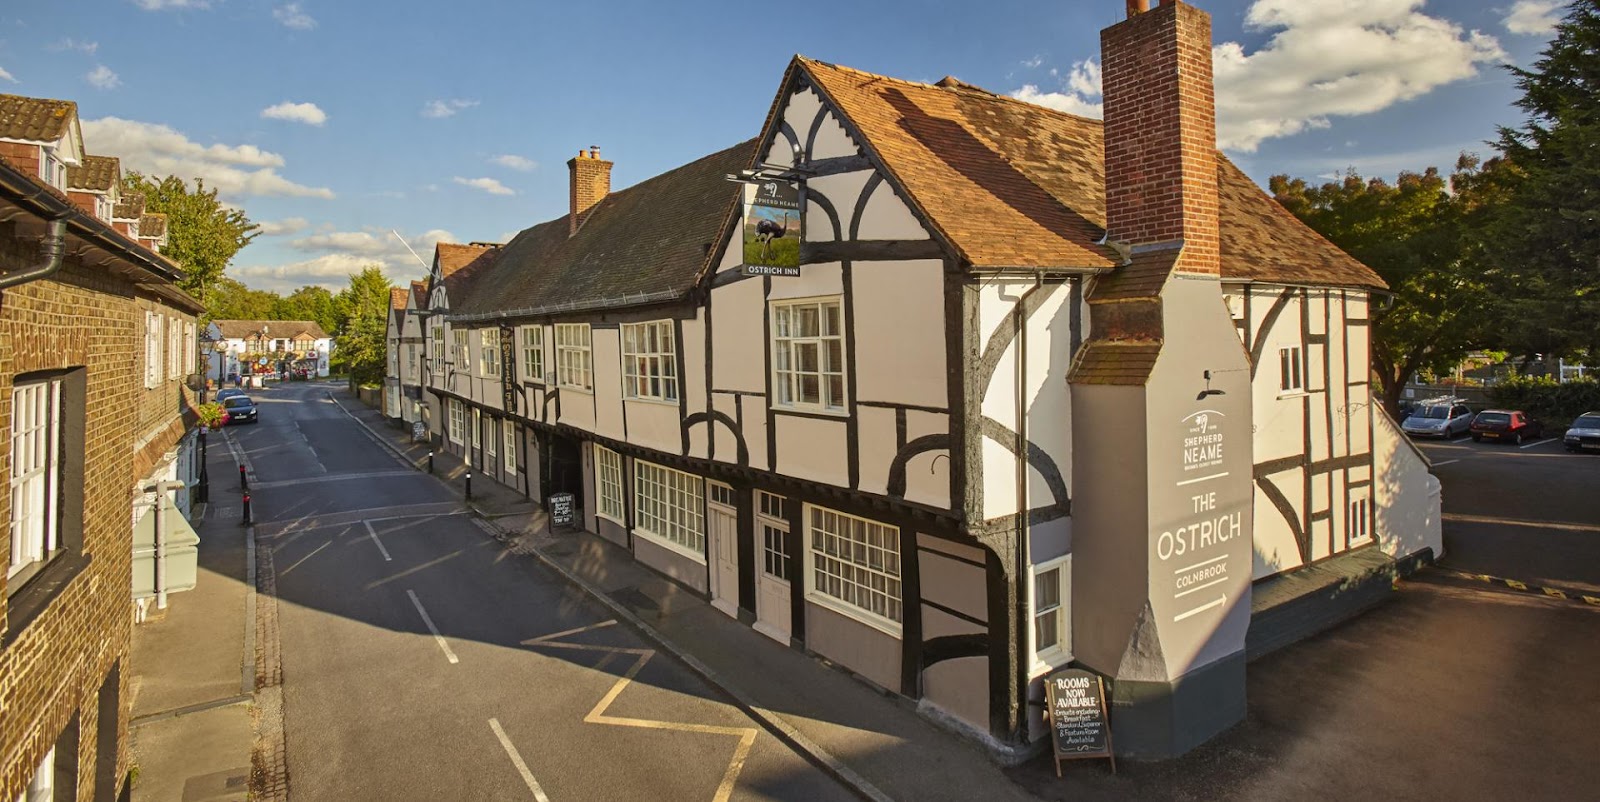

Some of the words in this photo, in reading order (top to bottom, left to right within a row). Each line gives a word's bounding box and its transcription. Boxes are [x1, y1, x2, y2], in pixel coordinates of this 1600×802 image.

[748, 265, 782, 275] OSTRICH
[1184, 433, 1223, 447] SHEPHERD
[1184, 443, 1223, 464] NEAME
[1191, 491, 1216, 514] THE
[1157, 511, 1241, 561] OSTRICH
[1176, 562, 1227, 589] COLNBROOK
[1057, 677, 1090, 689] ROOMS
[1065, 688, 1086, 698] NOW
[1056, 696, 1096, 708] AVAILABLE
